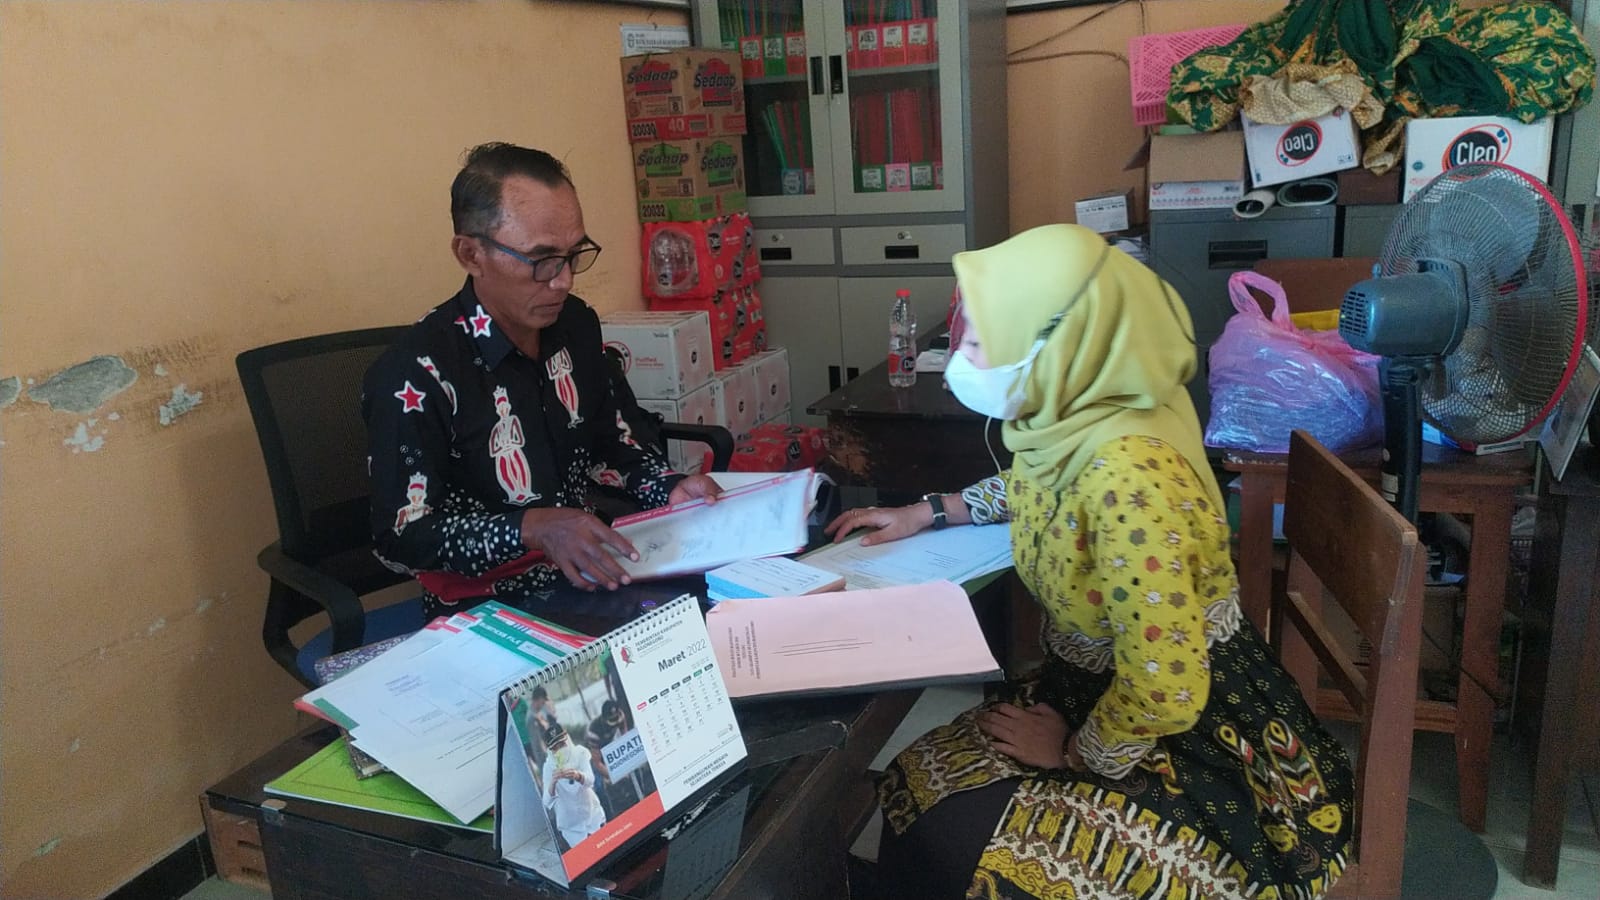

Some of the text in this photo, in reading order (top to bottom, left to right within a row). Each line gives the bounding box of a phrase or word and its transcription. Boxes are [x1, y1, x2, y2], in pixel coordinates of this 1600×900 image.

[627, 69, 678, 84] Sedaap
[694, 72, 736, 90] Sedaap
[1285, 133, 1315, 152] Cleo
[1456, 141, 1497, 165] Cleo
[657, 638, 707, 673] Maret 2022
[606, 734, 643, 765] BUPATI
